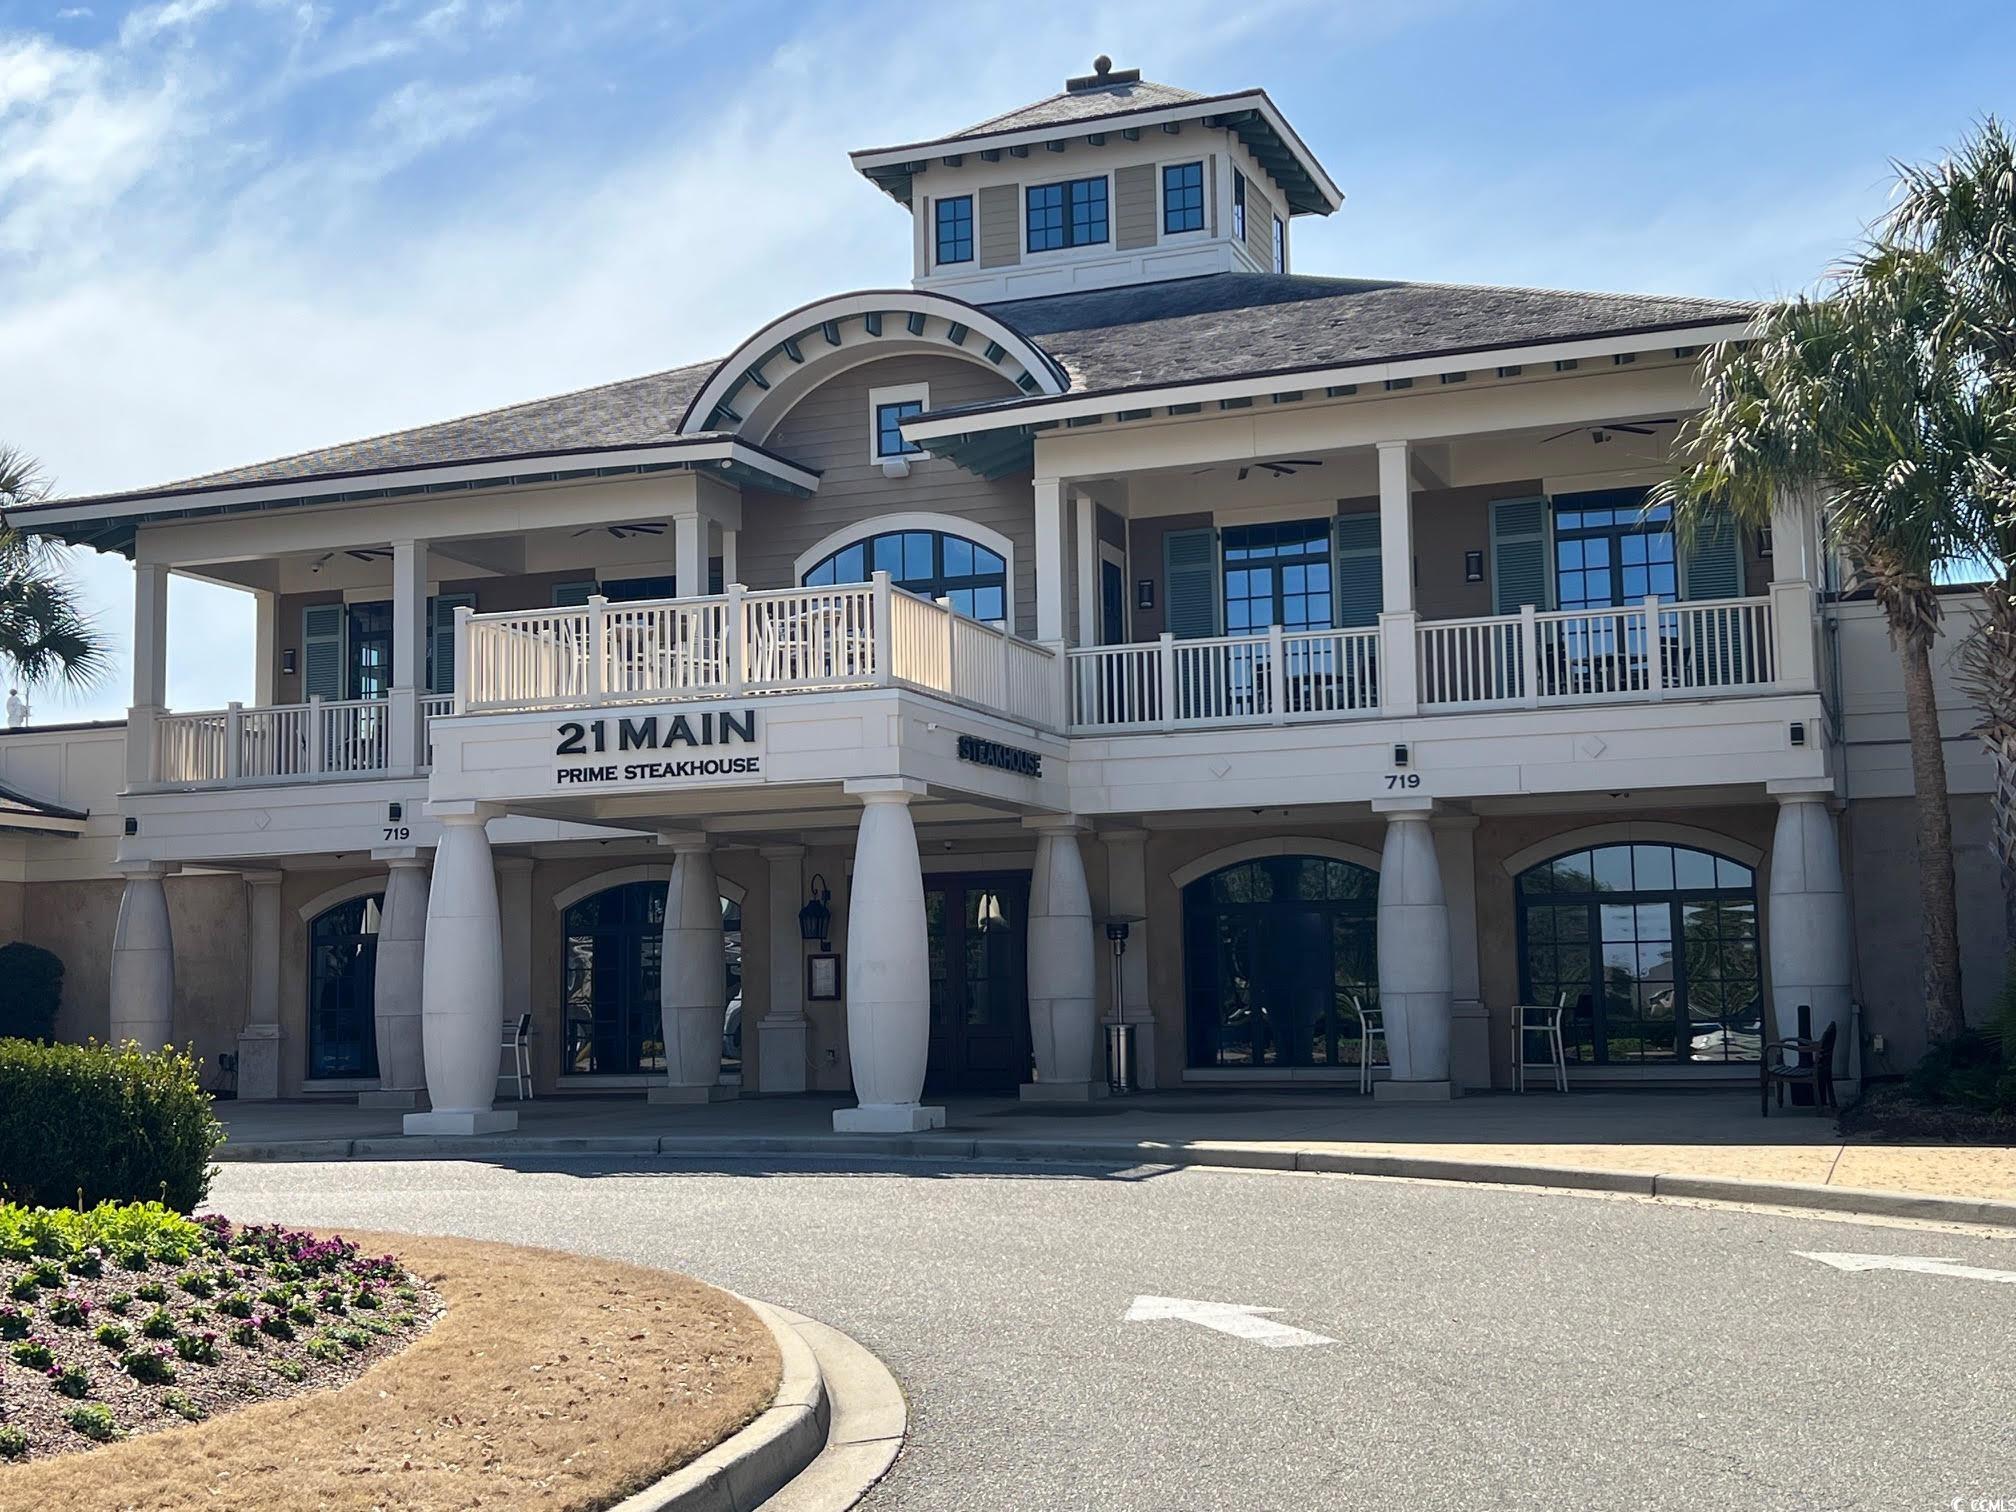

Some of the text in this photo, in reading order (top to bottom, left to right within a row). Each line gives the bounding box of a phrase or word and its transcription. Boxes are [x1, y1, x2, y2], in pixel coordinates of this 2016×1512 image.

[556, 710, 755, 755] 21 MAIN
[958, 735, 1042, 778] STEAKHOUSE
[557, 757, 760, 784] PRIME STEAKHOUSE
[1384, 774, 1421, 790] 719
[383, 827, 410, 841] 719
